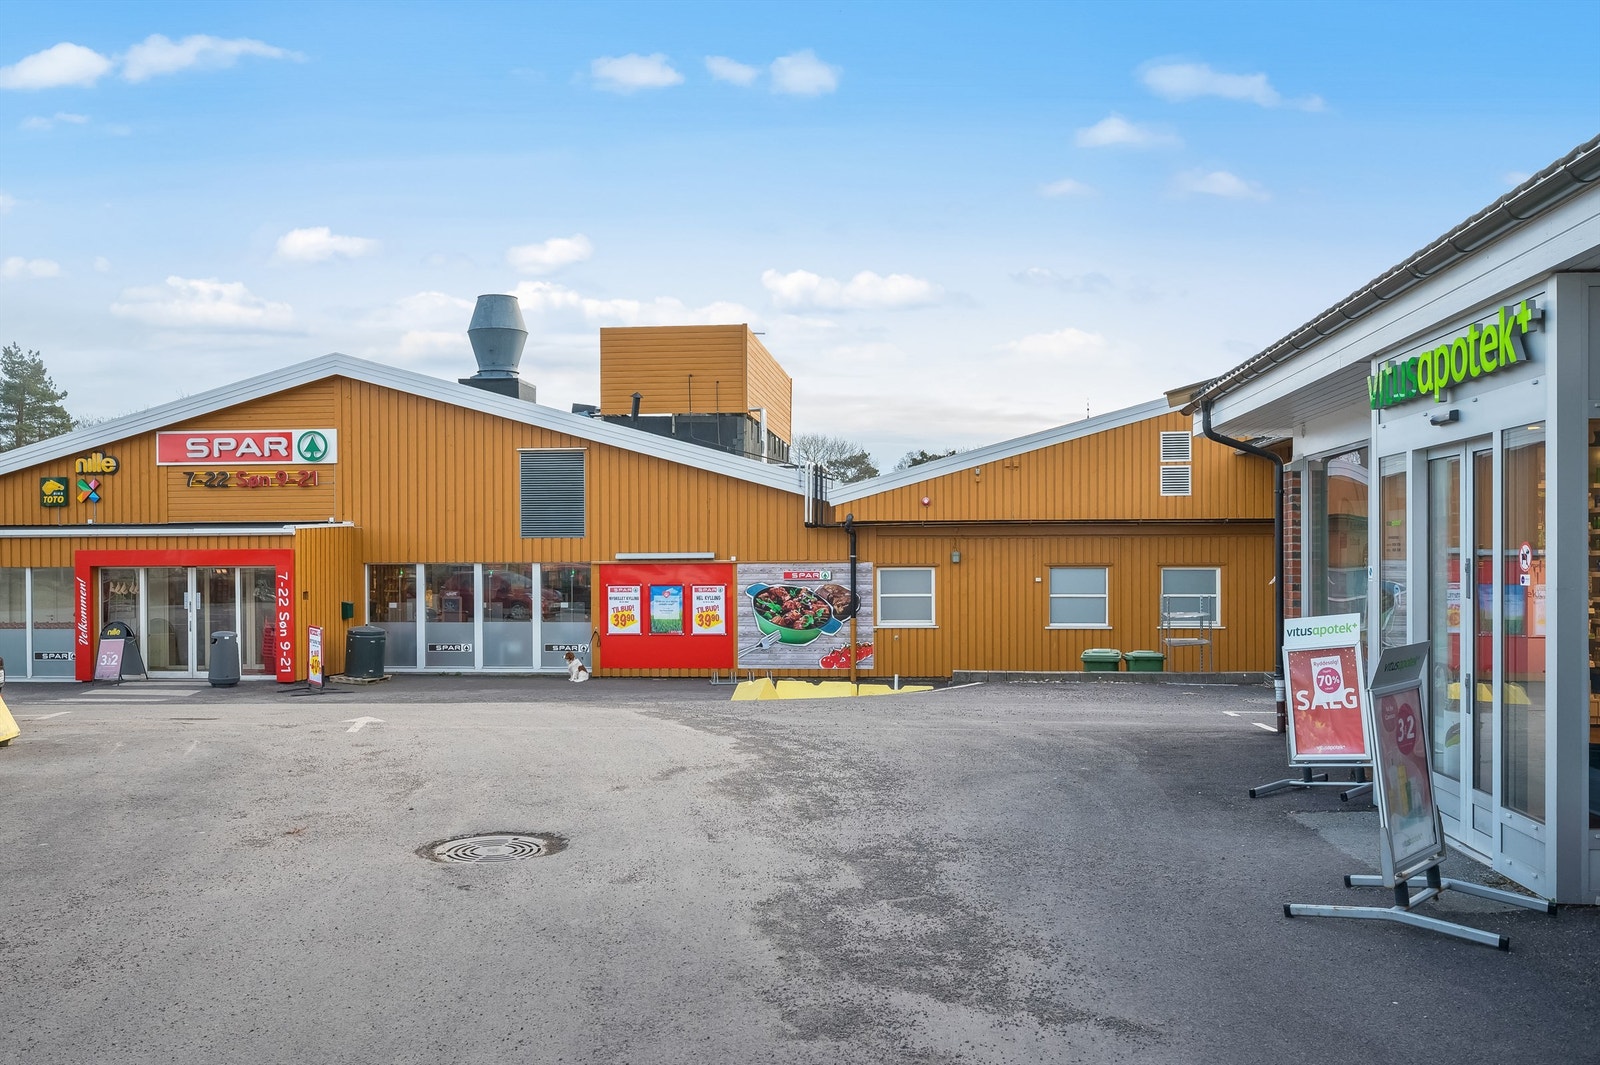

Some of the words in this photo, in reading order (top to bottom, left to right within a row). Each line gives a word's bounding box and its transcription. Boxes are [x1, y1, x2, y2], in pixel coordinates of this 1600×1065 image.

[185, 437, 289, 458] SPAR
[75, 452, 118, 473] nille
[183, 471, 231, 488] 7-22
[235, 470, 271, 488] Søn
[275, 470, 318, 488] 9-21
[277, 572, 289, 607] 7-22
[76, 577, 89, 646] Velkommen!
[611, 604, 635, 614] TILBUD!
[279, 612, 290, 637] Søn
[42, 652, 68, 660] SPAR
[280, 641, 291, 673] 9-21
[1318, 674, 1340, 687] 70%
